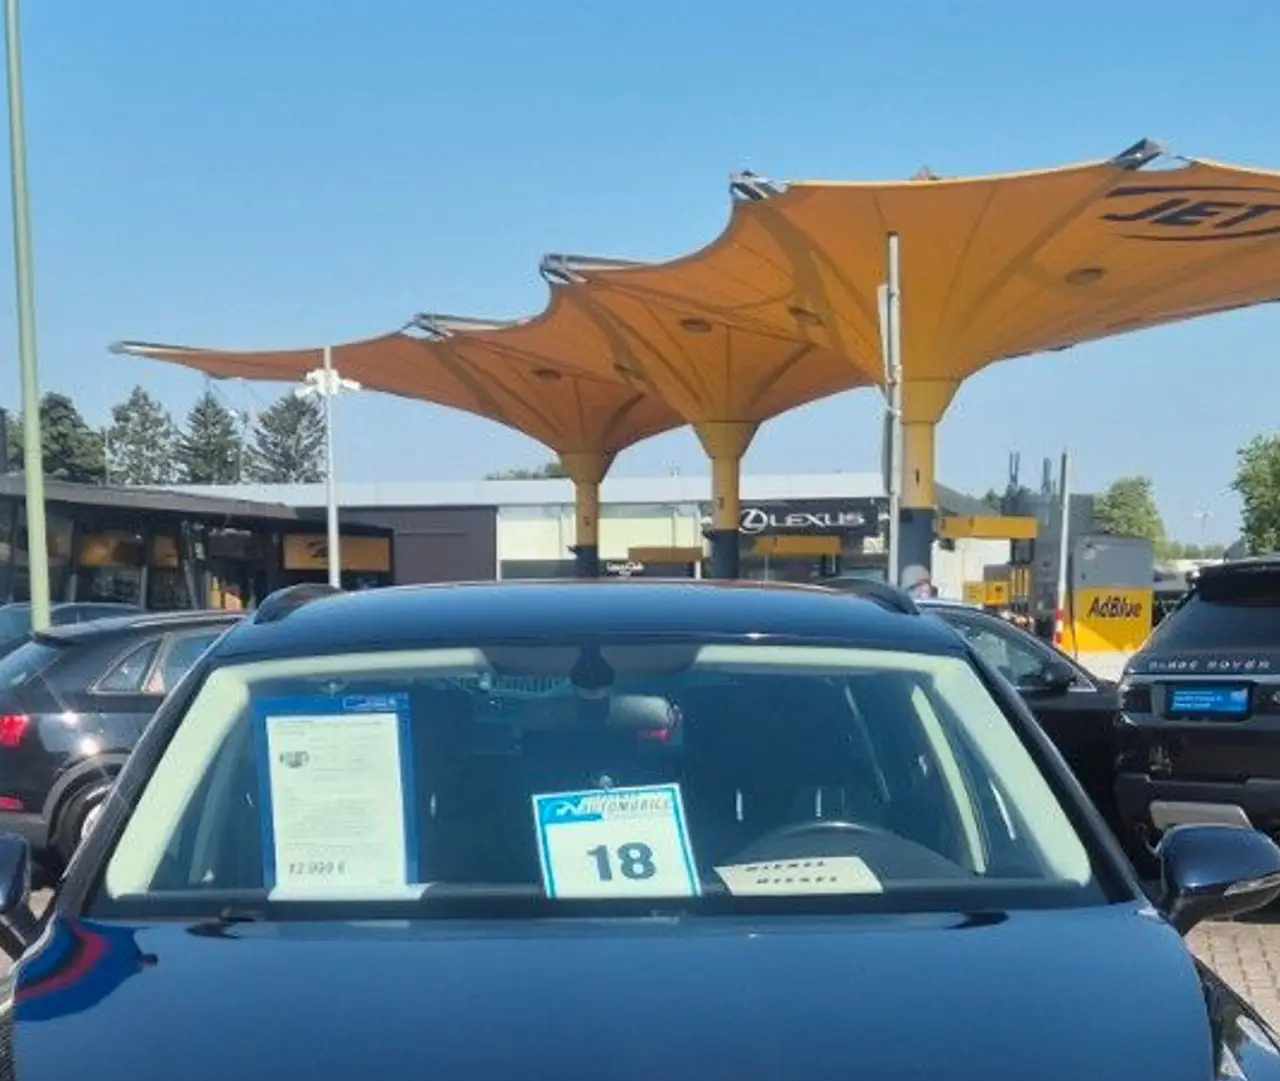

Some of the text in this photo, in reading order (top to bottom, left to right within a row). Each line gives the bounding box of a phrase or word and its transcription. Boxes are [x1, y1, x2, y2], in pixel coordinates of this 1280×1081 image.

[770, 512, 866, 529] LEXUS
[1086, 595, 1143, 618] AdBlue
[586, 842, 656, 882] 18
